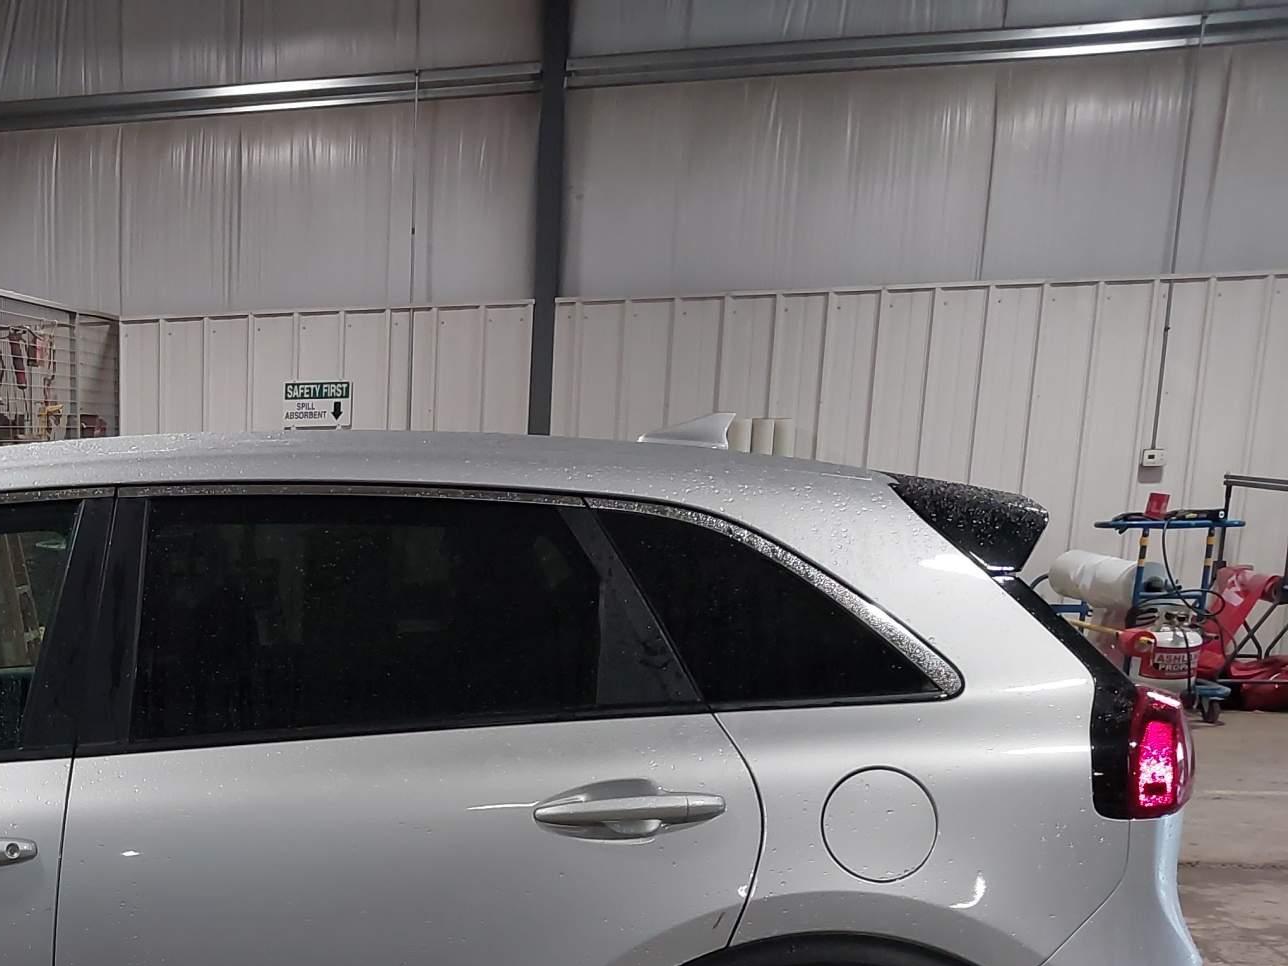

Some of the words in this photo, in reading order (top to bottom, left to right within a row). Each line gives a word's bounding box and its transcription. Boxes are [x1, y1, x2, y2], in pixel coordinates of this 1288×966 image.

[287, 384, 321, 398] SAFETY
[322, 383, 348, 397] FIRST
[296, 402, 315, 411] SPILL
[285, 411, 327, 420] ABSORBENT
